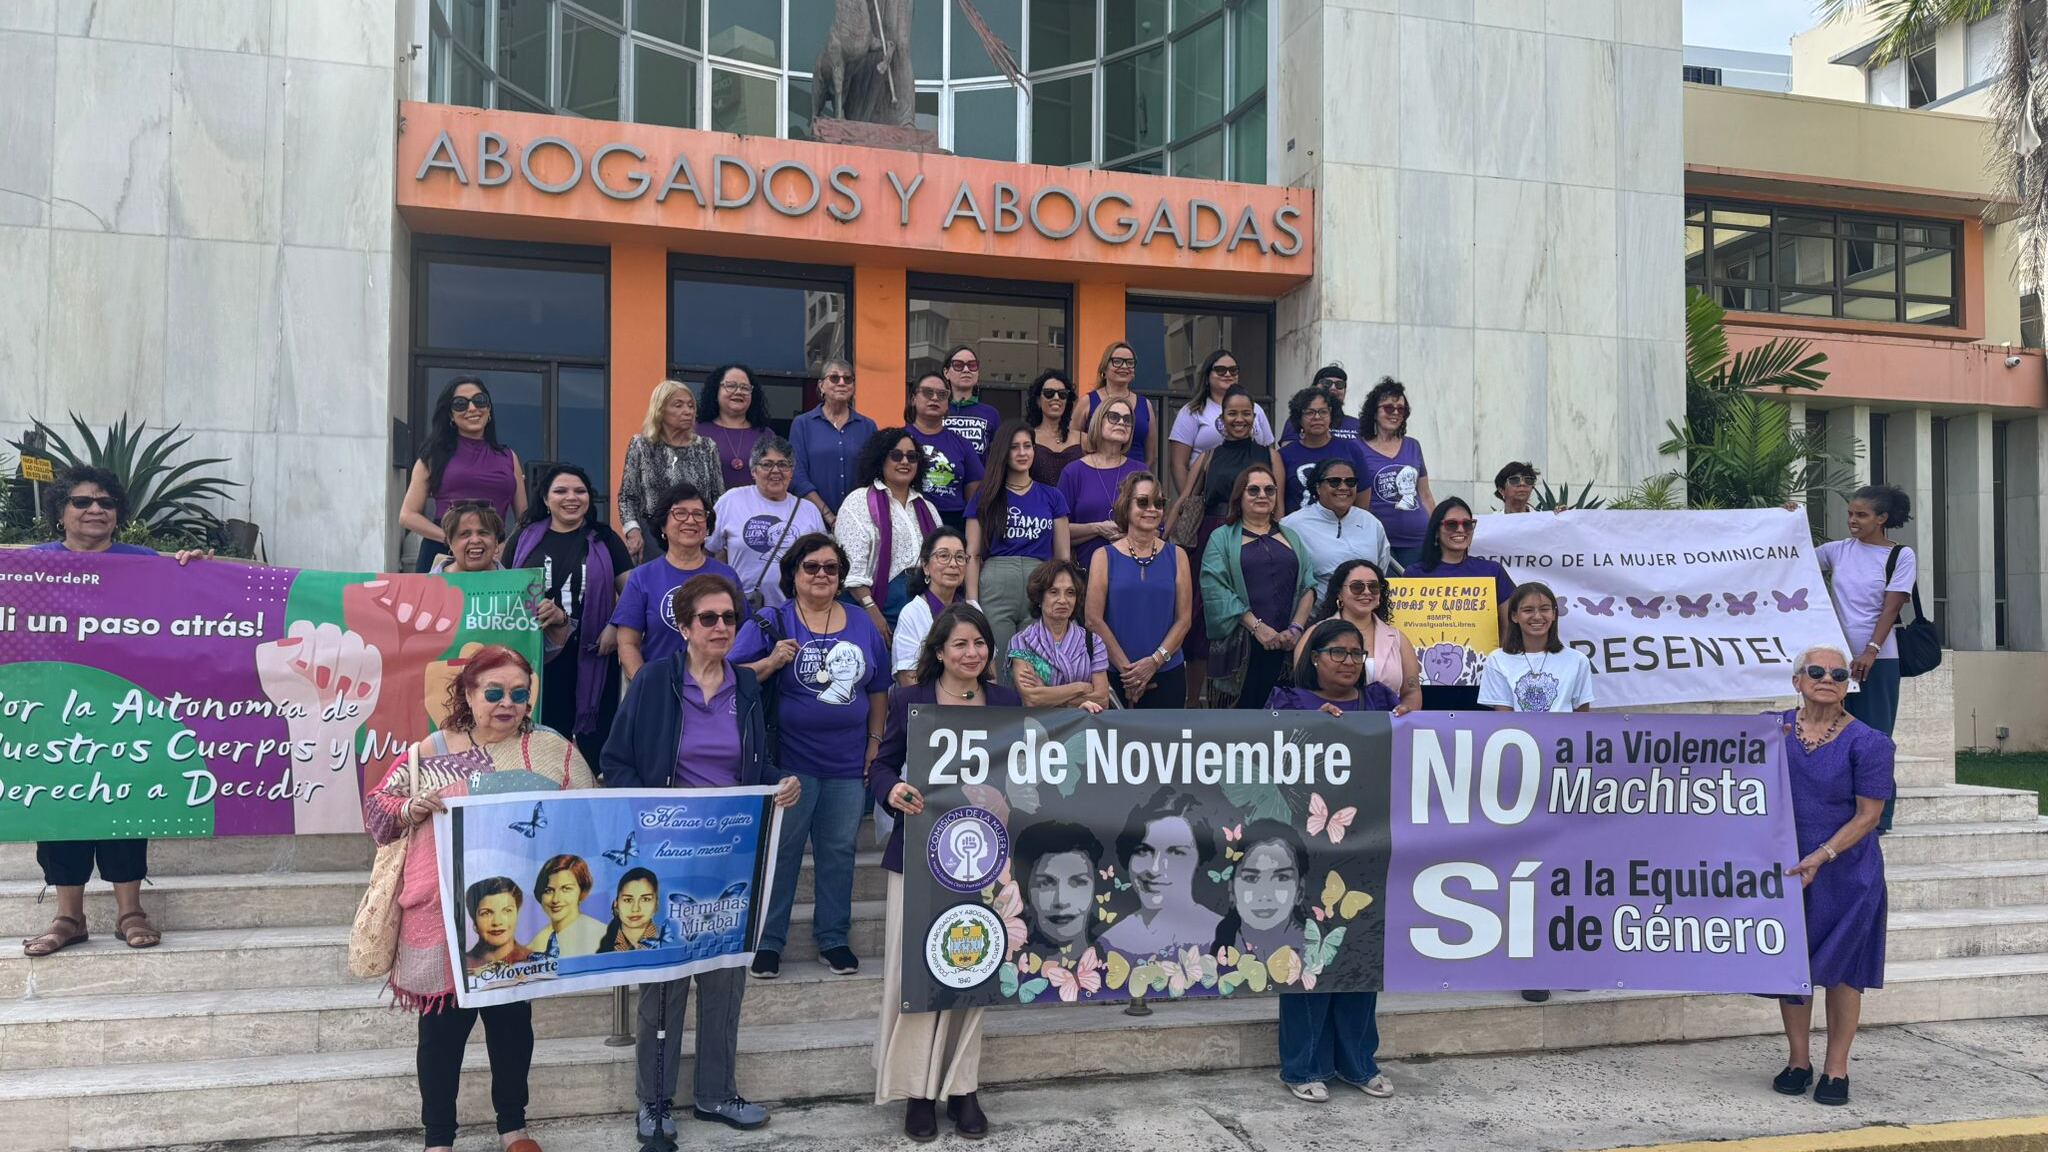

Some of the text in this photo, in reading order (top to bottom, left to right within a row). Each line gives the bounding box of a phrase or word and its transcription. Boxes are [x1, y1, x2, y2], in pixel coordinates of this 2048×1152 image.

[415, 128, 1304, 256] ABOGADOS Y ABOGADAS
[1004, 527, 1041, 540] ODAS
[1562, 553, 1585, 568] DE
[1593, 553, 1614, 567] LA
[1620, 552, 1678, 567] MUJER
[1684, 545, 1800, 565] DOMINICANA
[466, 596, 526, 617] JULIA
[1389, 586, 1488, 598] NOS QUEREMOS
[27, 614, 68, 633] un
[78, 615, 160, 641] paso
[170, 611, 265, 637] atrás!
[466, 616, 539, 631] BURGOS
[0, 688, 359, 725] or la Autonomía de
[0, 732, 152, 764] uestros
[167, 729, 316, 768] Cuerpos
[329, 738, 349, 771] y
[927, 728, 1351, 786] 25 de Noviembre
[1555, 730, 1767, 764] a la Violencia
[0, 768, 325, 807] erecho a Decidir
[1411, 728, 1541, 824] NO
[1548, 766, 1768, 815] Machista
[965, 808, 978, 817] DE
[980, 811, 990, 823] LA
[991, 820, 1007, 850] MUJER
[1551, 859, 1785, 905] a la Equidad
[668, 895, 748, 920] Hermanas
[681, 911, 739, 936] Mirabal
[1549, 904, 1786, 955] de Género
[480, 961, 558, 981] Movearte
